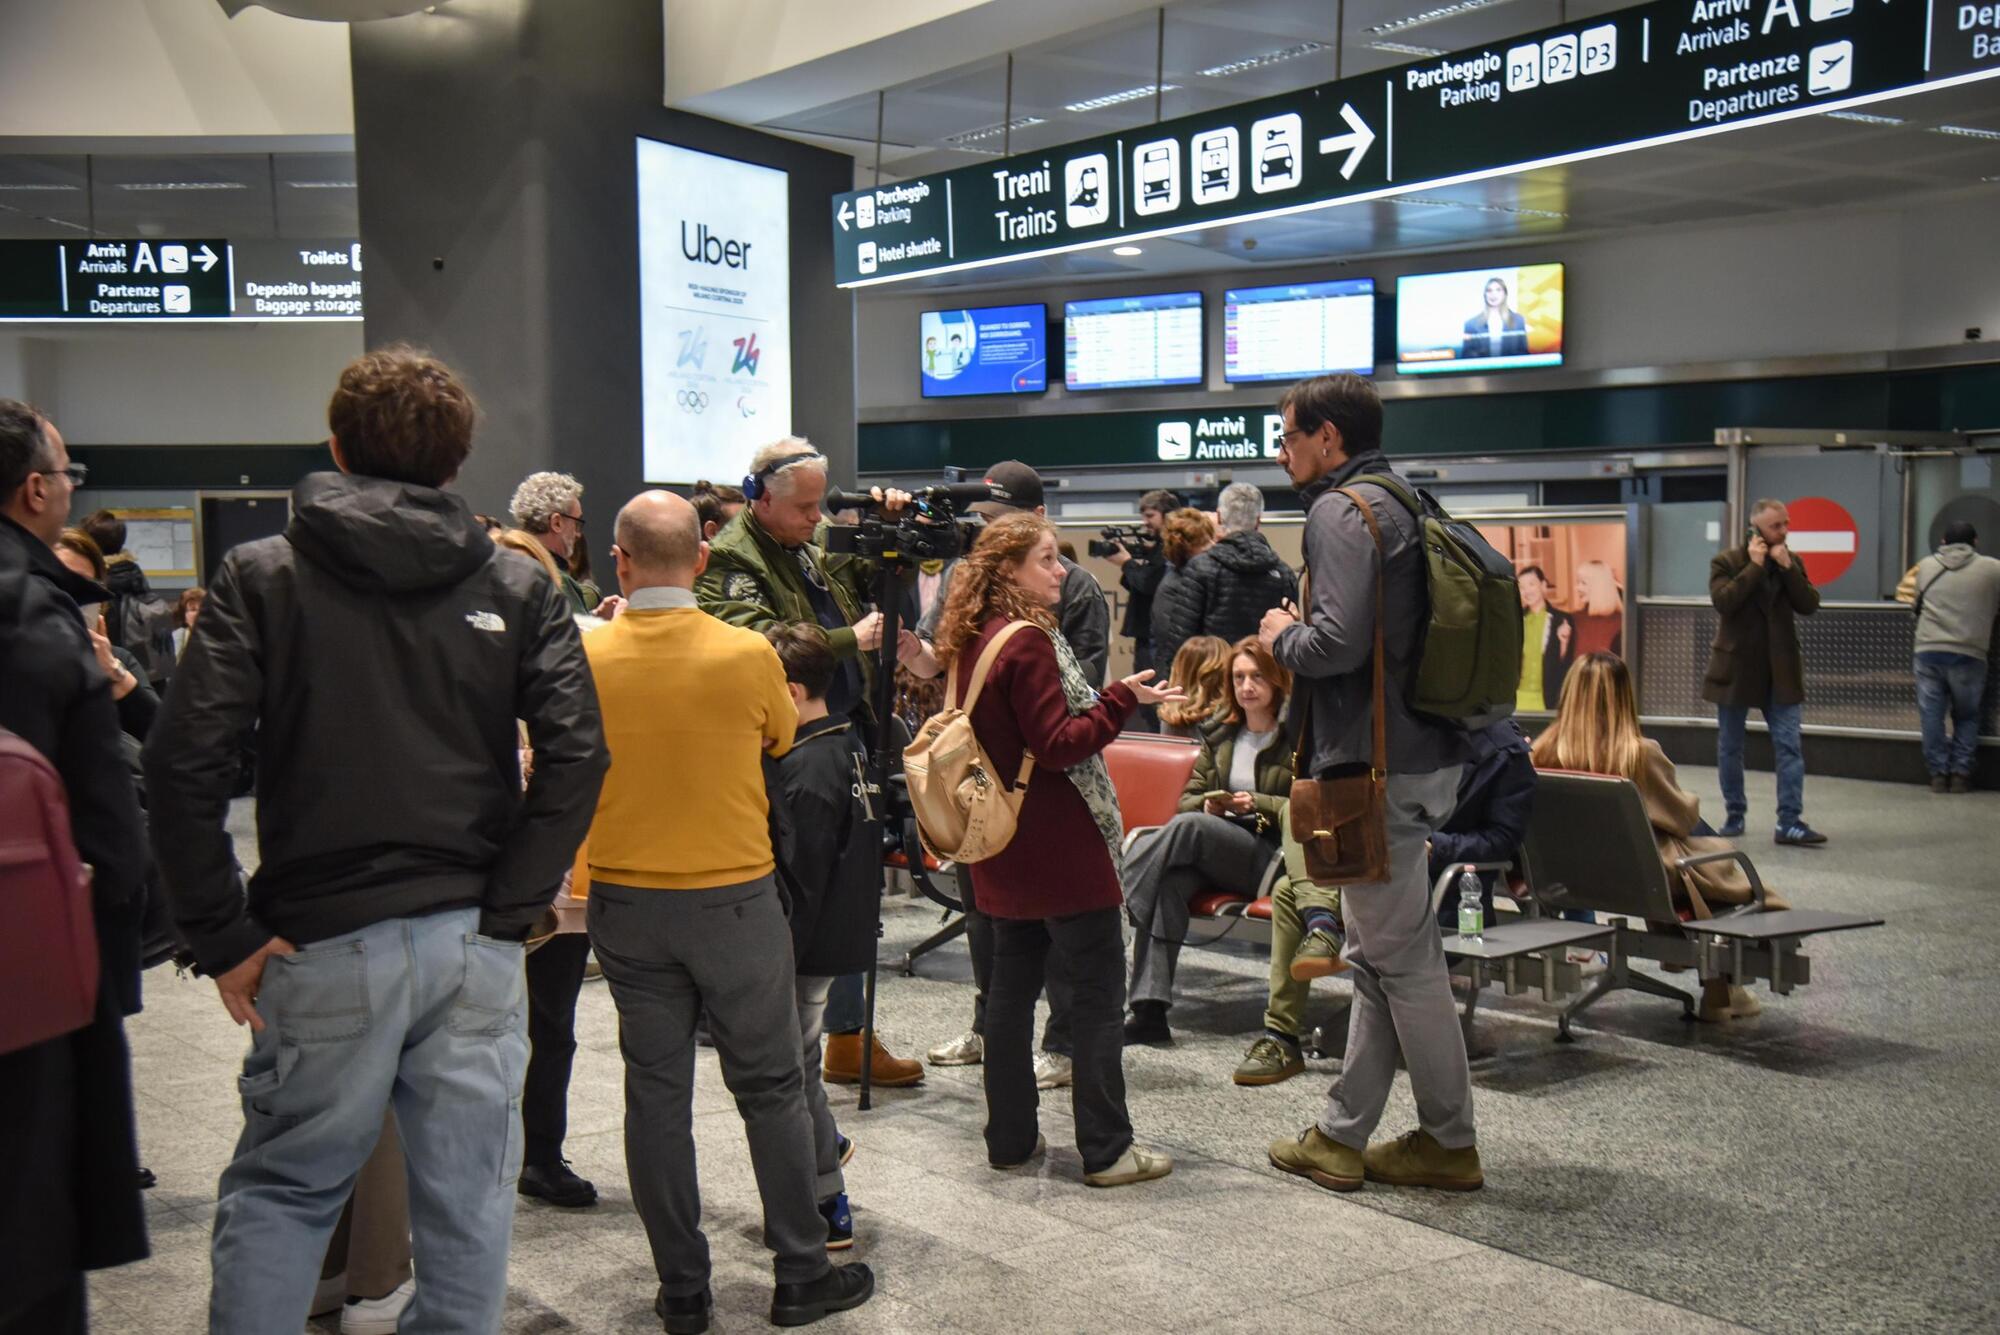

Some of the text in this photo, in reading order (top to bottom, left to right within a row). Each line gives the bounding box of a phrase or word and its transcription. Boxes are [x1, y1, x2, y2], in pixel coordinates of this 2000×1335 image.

[1691, 0, 1750, 24] Arrivi
[1761, 0, 1800, 35] A
[1676, 18, 1750, 55] Arrivals
[1407, 51, 1501, 91] Parcheggio
[1512, 43, 1611, 86] P1 P2 P3
[1703, 54, 1800, 91] Partenze
[1440, 81, 1500, 108] Parking
[1689, 83, 1800, 122] Departures
[876, 181, 930, 206] Parcheggio
[993, 160, 1051, 202] Treni
[877, 207, 911, 225] Parking
[995, 206, 1057, 242] Trains
[87, 243, 126, 258] Arrivi
[681, 219, 752, 270] Uber
[878, 237, 942, 263] Hotel shuttle
[78, 260, 128, 274] Arrivals
[133, 242, 158, 273] A
[300, 250, 349, 265] Toilets
[98, 283, 160, 298] Partenze
[246, 281, 361, 299] Deposito bagagli
[89, 299, 161, 316] Departures
[256, 298, 362, 315] Baggage storage
[1195, 416, 1245, 437] Arrivi
[1195, 438, 1258, 459] Arrivals
